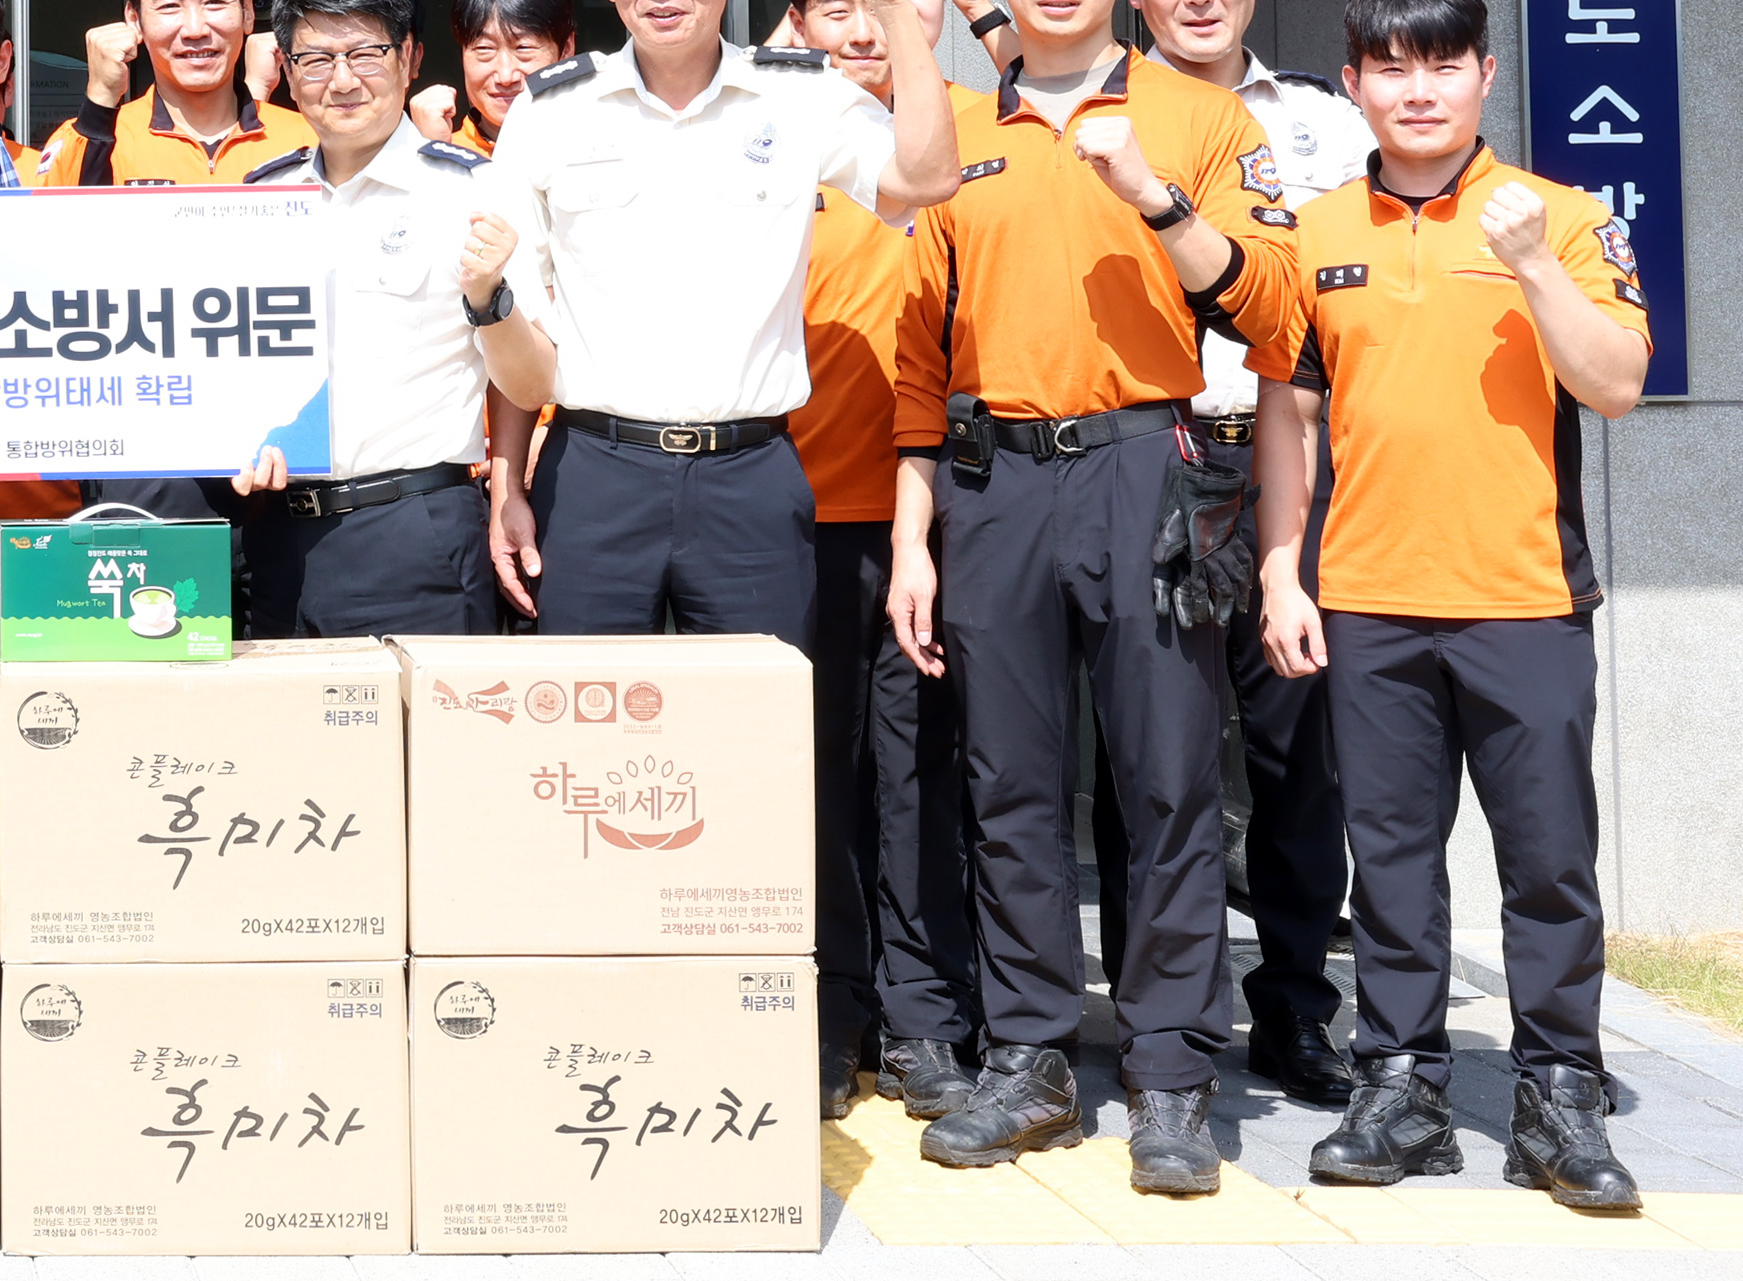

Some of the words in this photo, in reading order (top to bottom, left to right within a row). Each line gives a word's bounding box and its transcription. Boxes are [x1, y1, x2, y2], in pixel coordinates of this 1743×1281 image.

[285, 201, 313, 216] 진도
[191, 287, 315, 357] 위문
[136, 375, 192, 405] 확립
[7, 439, 123, 458] 통합방위협의회
[57, 600, 89, 608] Mugwort
[92, 599, 106, 607] Tea
[187, 631, 200, 641] 42
[324, 710, 377, 726] 취급주의
[530, 762, 696, 859] 하루에세끼
[137, 785, 361, 890] 흑미차
[660, 888, 802, 902] 하루에세끼영농조합법인
[31, 912, 83, 922] 하루에세끼
[90, 912, 153, 922] 영농조합법인
[661, 907, 680, 918] 전남
[684, 907, 714, 917] 진도군
[718, 907, 747, 917] 지산면
[786, 907, 803, 916] 174
[242, 917, 384, 936] 20gX42포X12개입
[661, 923, 715, 935] 고객상담실
[720, 923, 803, 933] 061-543-7002
[328, 1003, 382, 1018] 취급주의
[741, 995, 794, 1011] 취급주의
[141, 1078, 365, 1183] 흑미차
[555, 1076, 778, 1180] 흑미차
[33, 1206, 86, 1215] 하루에세끼
[93, 1205, 156, 1215] 영농조합법인
[444, 1204, 496, 1213] 하루에세끼
[503, 1203, 566, 1213] 영농조합법인
[243, 1211, 389, 1231] 20gX42포X12개입
[660, 1206, 802, 1226] 20gX42포X12개입
[81, 1228, 156, 1236] 061-543-7002
[491, 1226, 567, 1234] 061-543-7002
